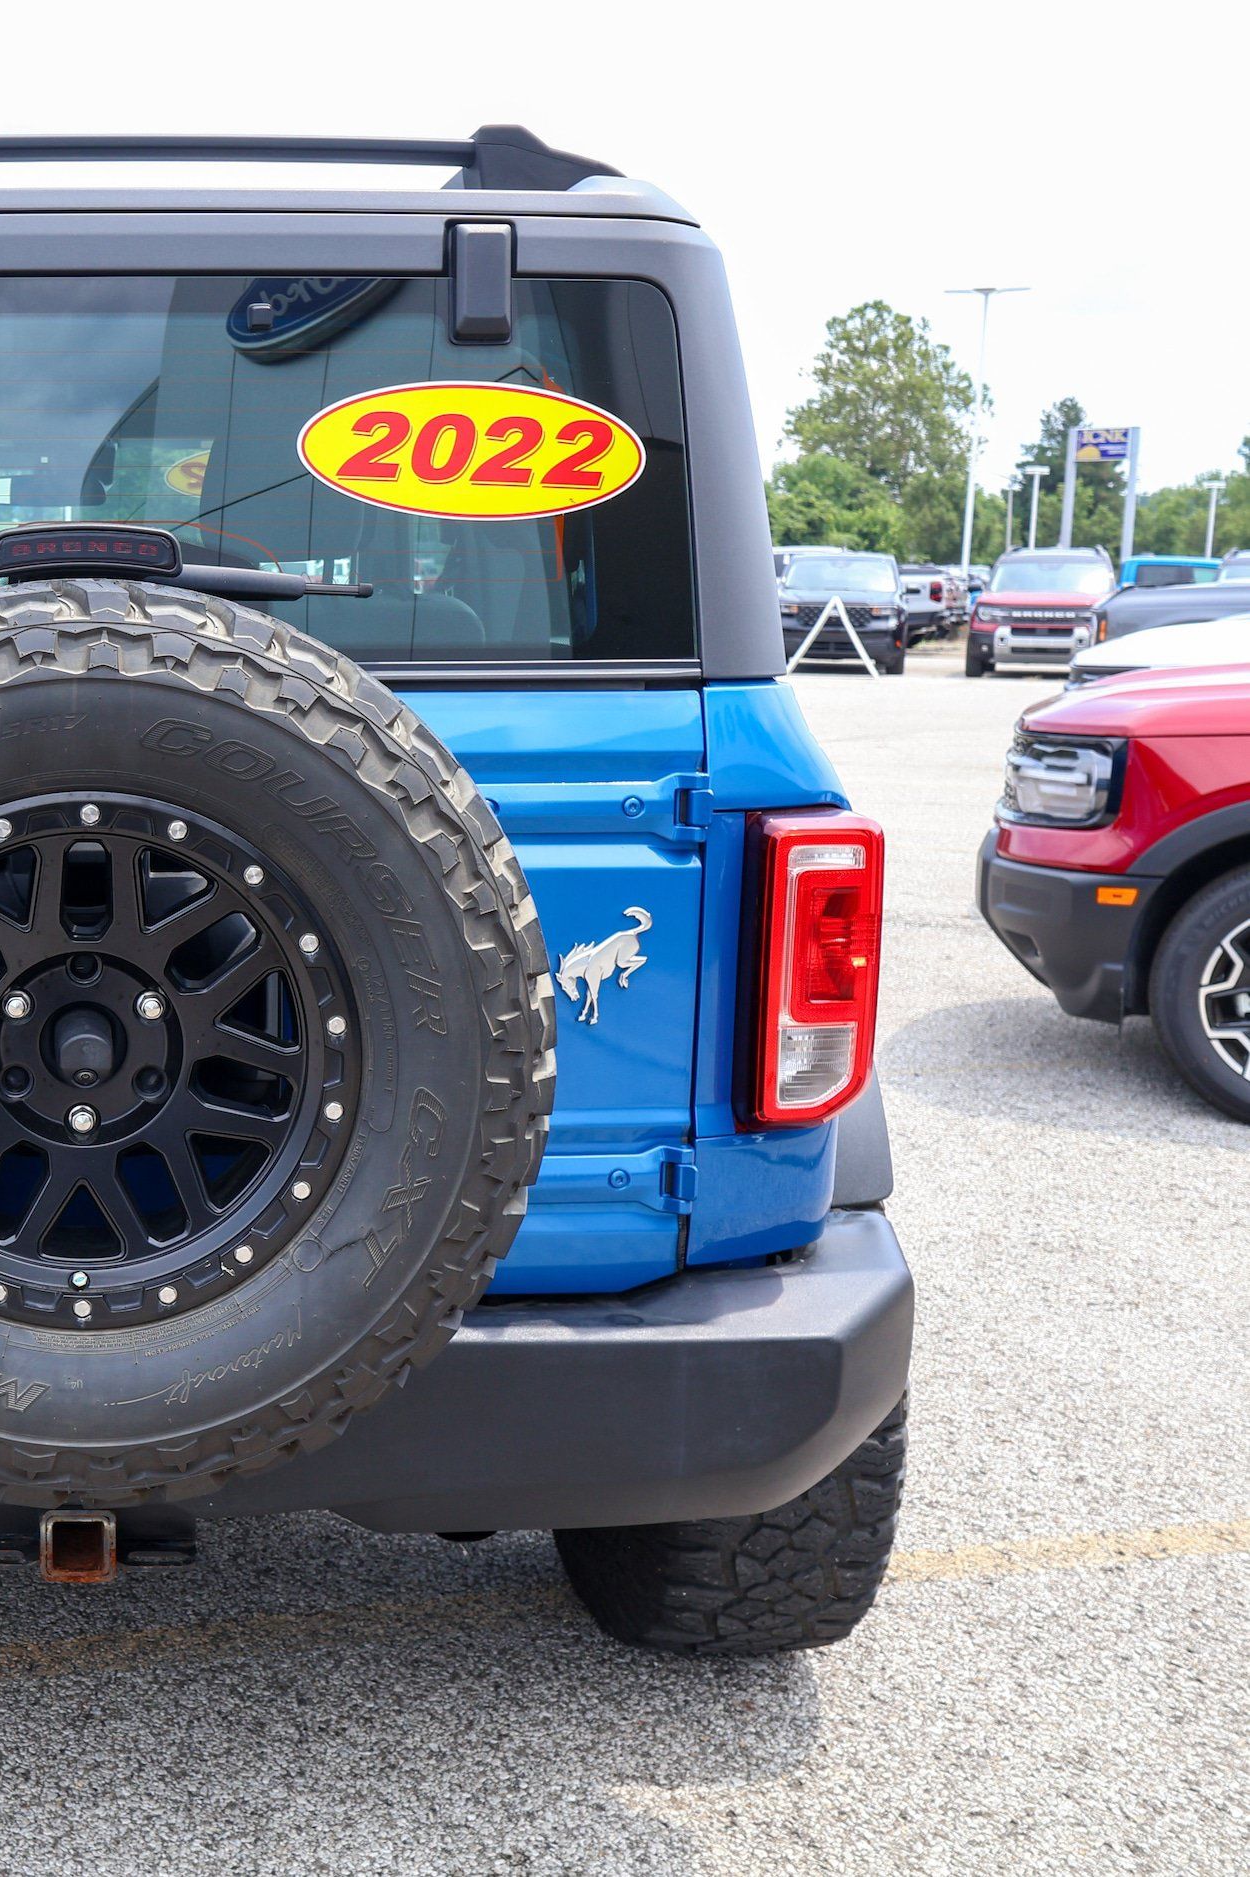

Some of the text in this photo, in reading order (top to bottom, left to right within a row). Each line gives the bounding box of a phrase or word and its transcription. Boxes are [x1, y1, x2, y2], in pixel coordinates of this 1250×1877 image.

[336, 410, 617, 490] 2022
[12, 541, 159, 556] BRONCO
[1011, 610, 1076, 619] BRONCO
[140, 717, 447, 1037] COURSER
[362, 1086, 448, 1292] CXT
[103, 1303, 303, 1407] Mastercraft
